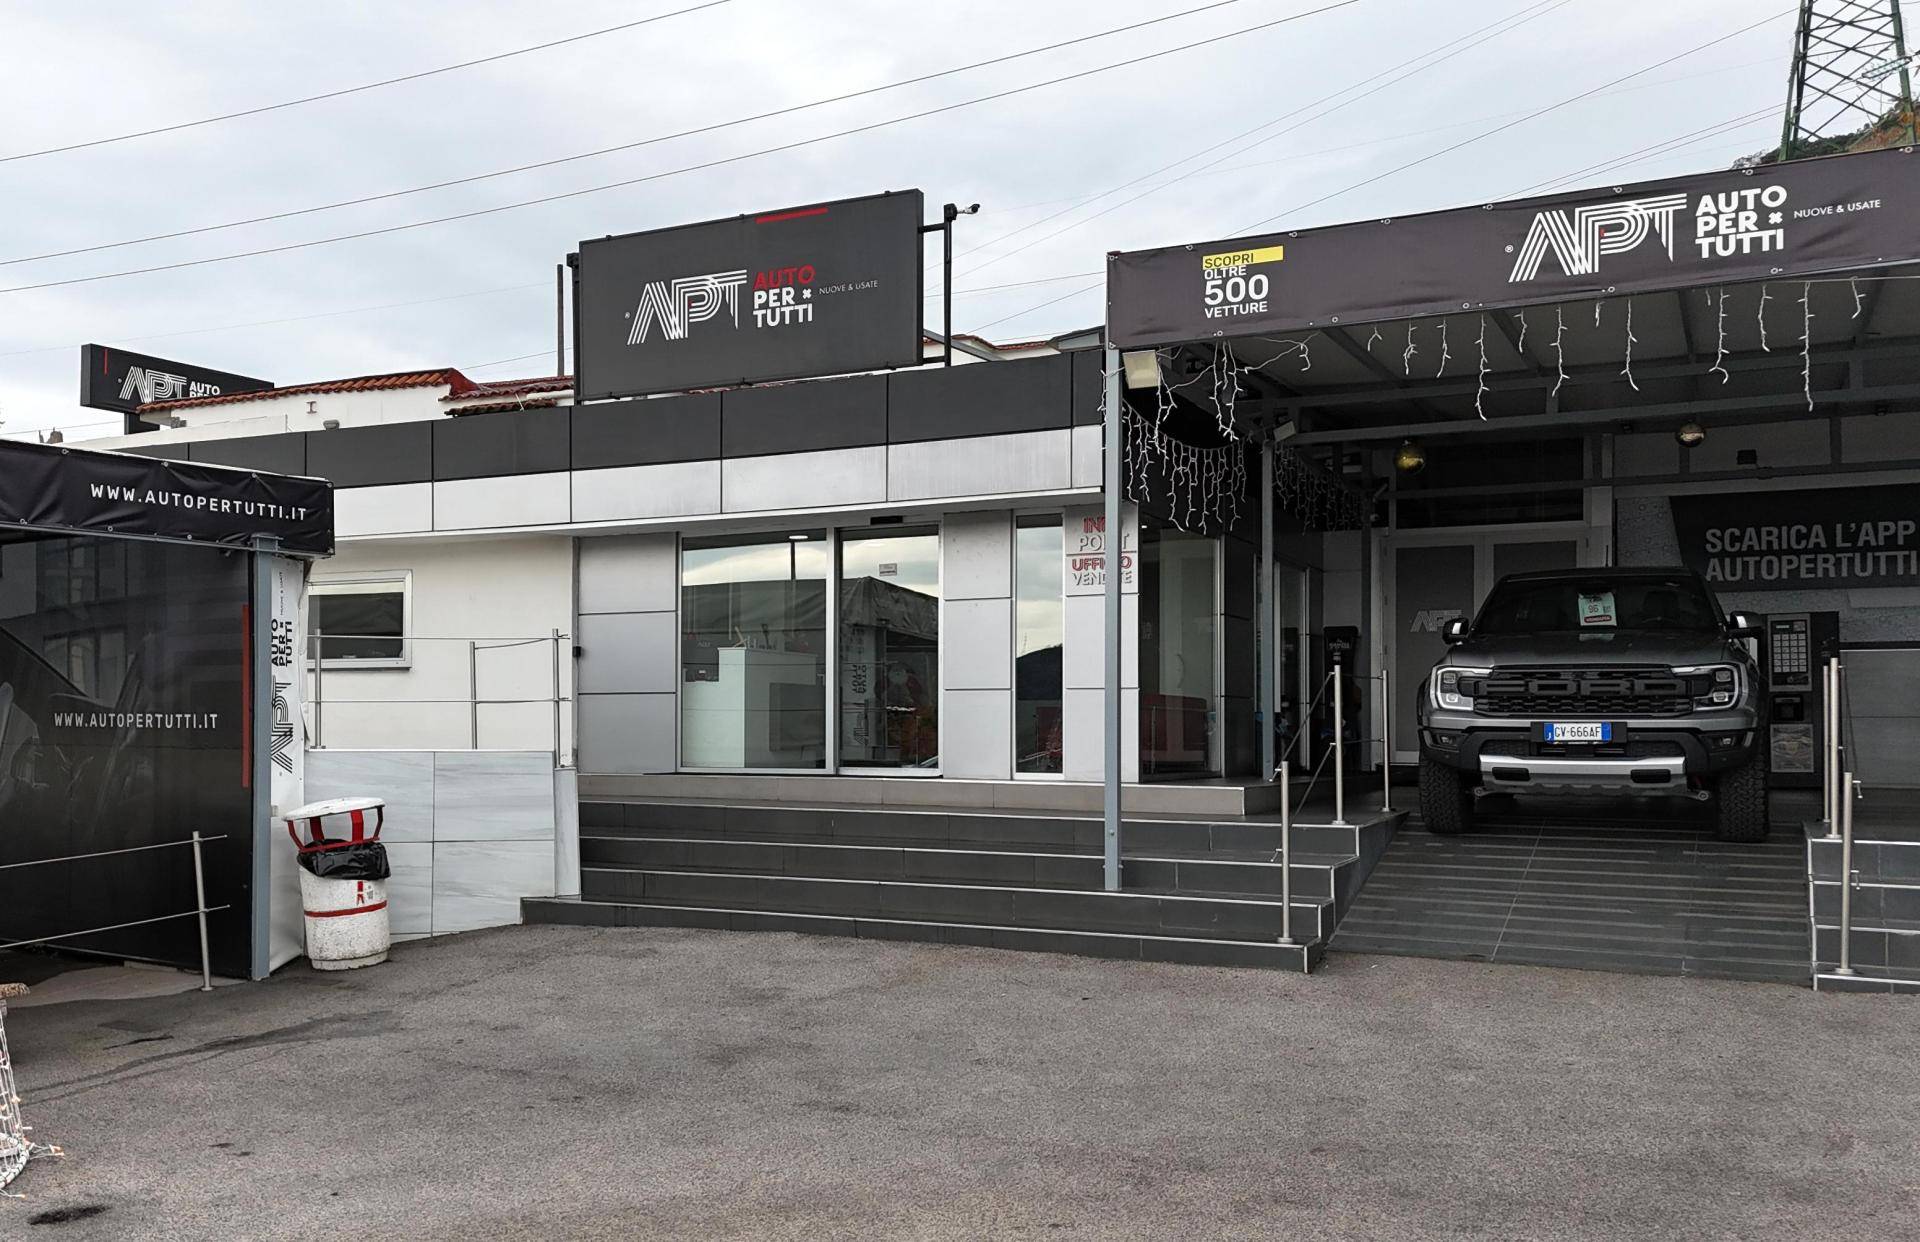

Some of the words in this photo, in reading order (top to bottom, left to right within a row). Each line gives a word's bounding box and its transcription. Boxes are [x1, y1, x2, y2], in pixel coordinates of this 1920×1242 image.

[1695, 185, 1788, 216] AUTO
[1793, 206, 1834, 220] NUOVE
[1837, 204, 1845, 213] &
[1847, 199, 1881, 212] USATE
[1508, 193, 1687, 283] APT
[1697, 212, 1759, 238] PER
[1695, 228, 1784, 259] TUTTI
[1204, 252, 1254, 269] SCOPRI
[1204, 264, 1247, 280] OLTRE
[752, 264, 816, 291] AUTO
[819, 284, 846, 296] NUOVE
[848, 282, 854, 291] &
[855, 280, 878, 290] USATE
[1204, 273, 1269, 306] 500
[627, 269, 748, 345] APT
[753, 286, 796, 310] PER
[1204, 301, 1268, 319] VETTURE
[752, 303, 813, 328] TUTTI
[189, 381, 221, 396] AUTO
[90, 483, 307, 521] WWW.AUTOPERTUTTI.IT
[1705, 524, 1828, 553] SCARICA
[1835, 520, 1917, 548] L'APP
[1072, 555, 1133, 571] UFFIO
[1705, 550, 1918, 582] AUTOPERTUTTI
[271, 618, 279, 667] AUTO
[278, 634, 286, 667] PER
[285, 621, 293, 667] TUTTI
[54, 712, 218, 729] WWW.AUTOPERTUTTI.IT
